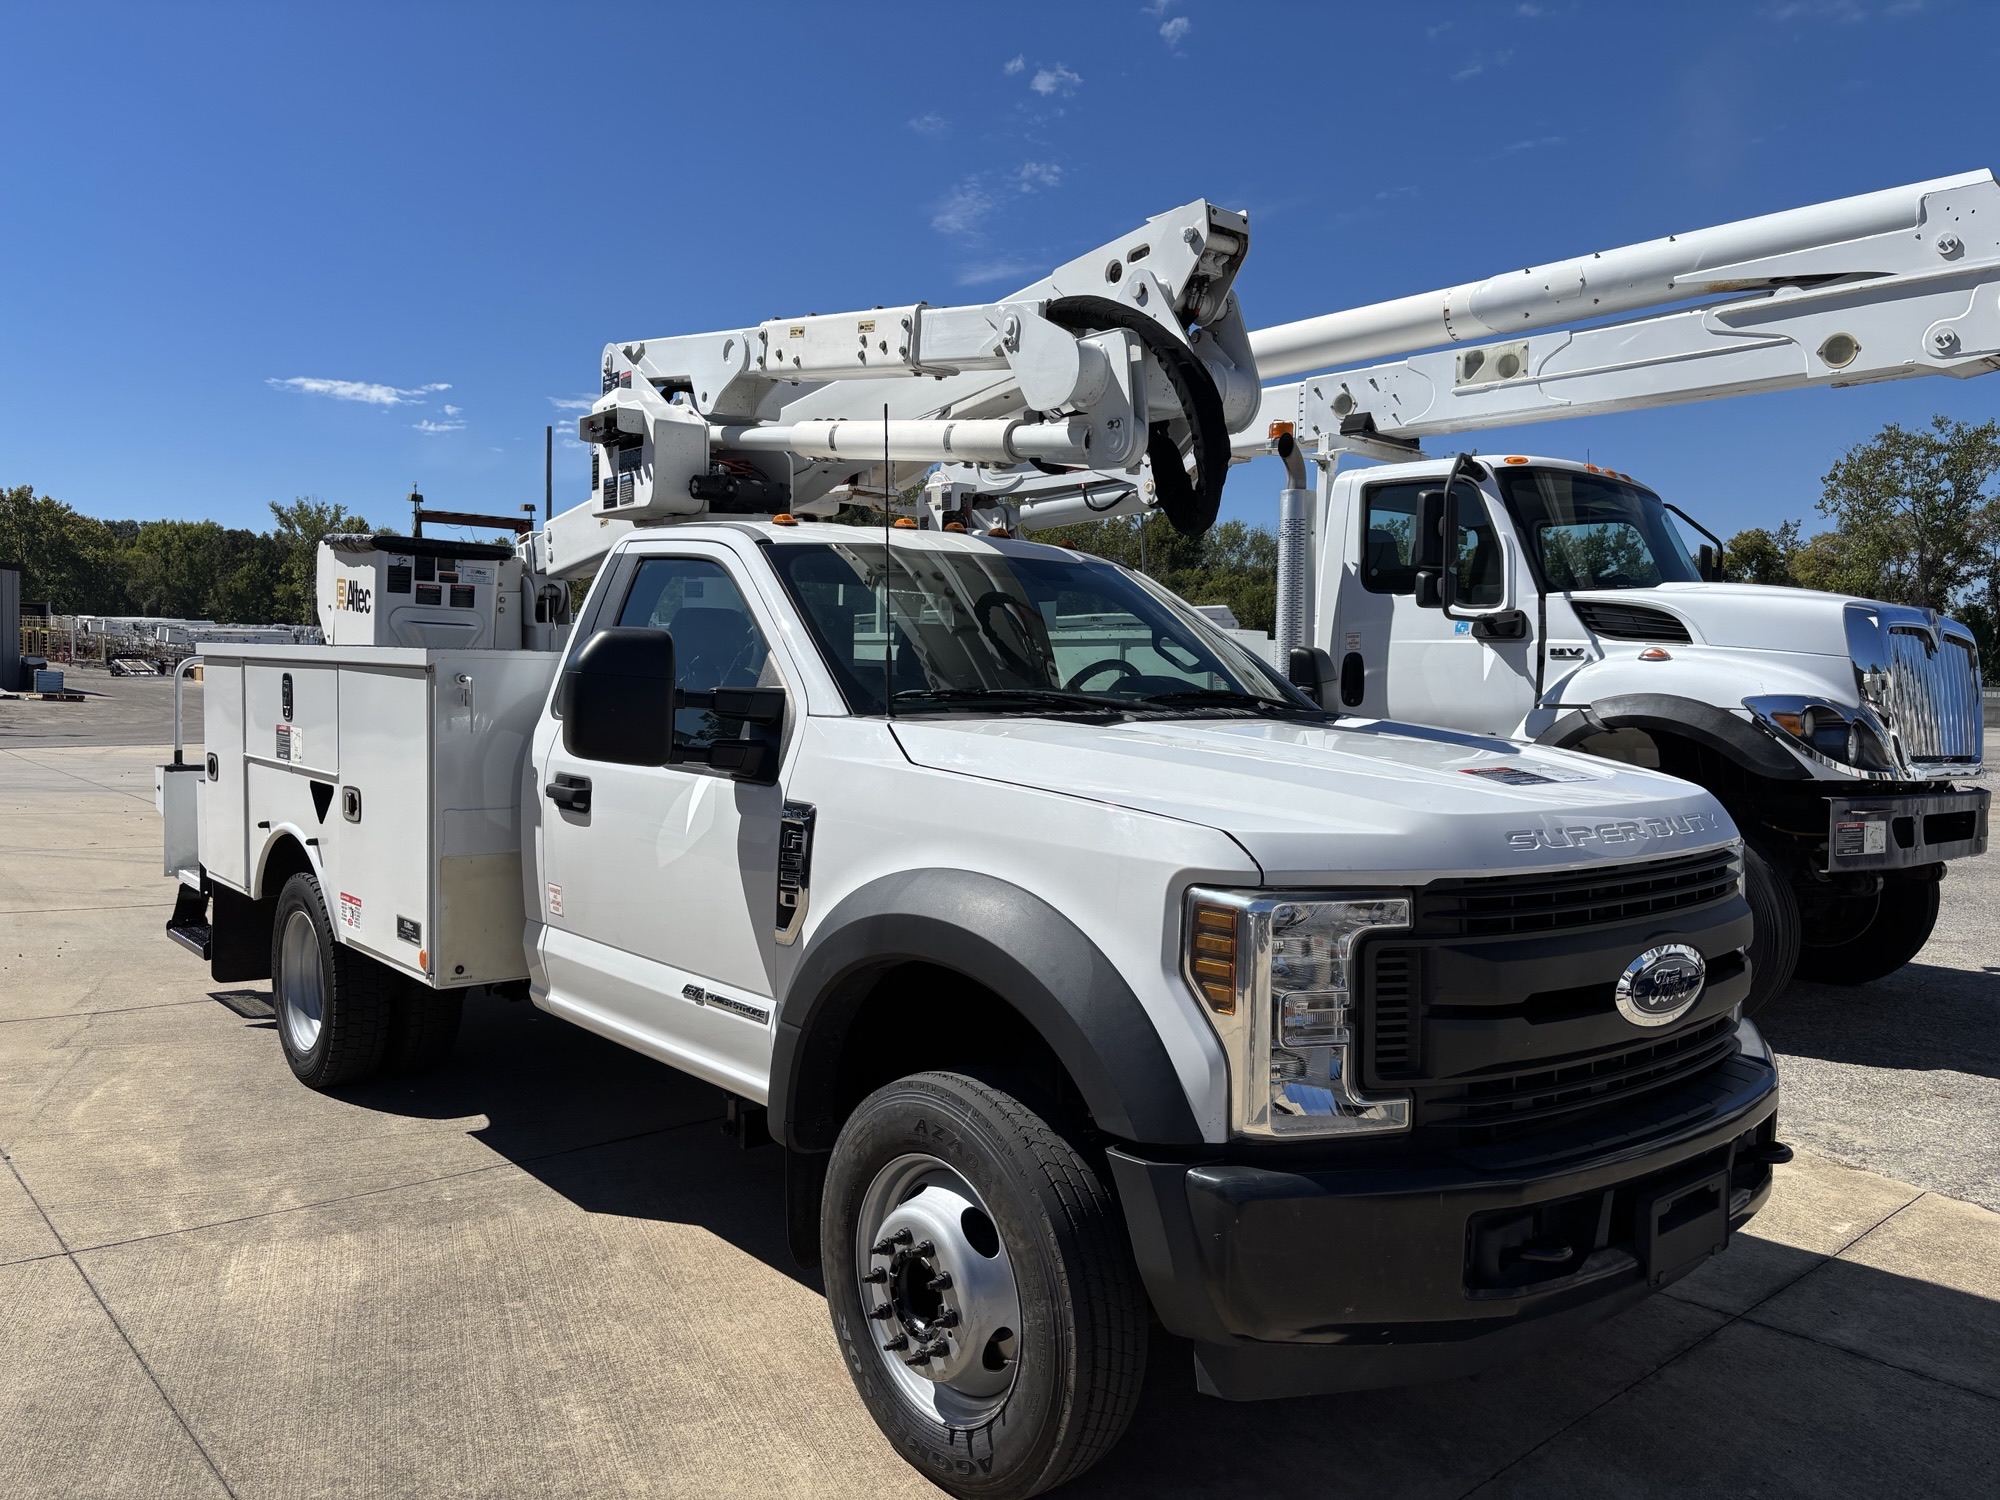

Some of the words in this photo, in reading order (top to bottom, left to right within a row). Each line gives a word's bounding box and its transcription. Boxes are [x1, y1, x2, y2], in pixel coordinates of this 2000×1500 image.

[347, 580, 371, 614] Altec
[1550, 648, 1585, 656] HV
[1505, 821, 1649, 851] SUPER
[1645, 811, 1719, 838] DUTY
[780, 829, 803, 908] F550
[706, 993, 732, 1008] POWER
[732, 1003, 765, 1018] STROKE
[1648, 966, 1690, 1006] Ford
[838, 1312, 994, 1478] AGGRESSOR
